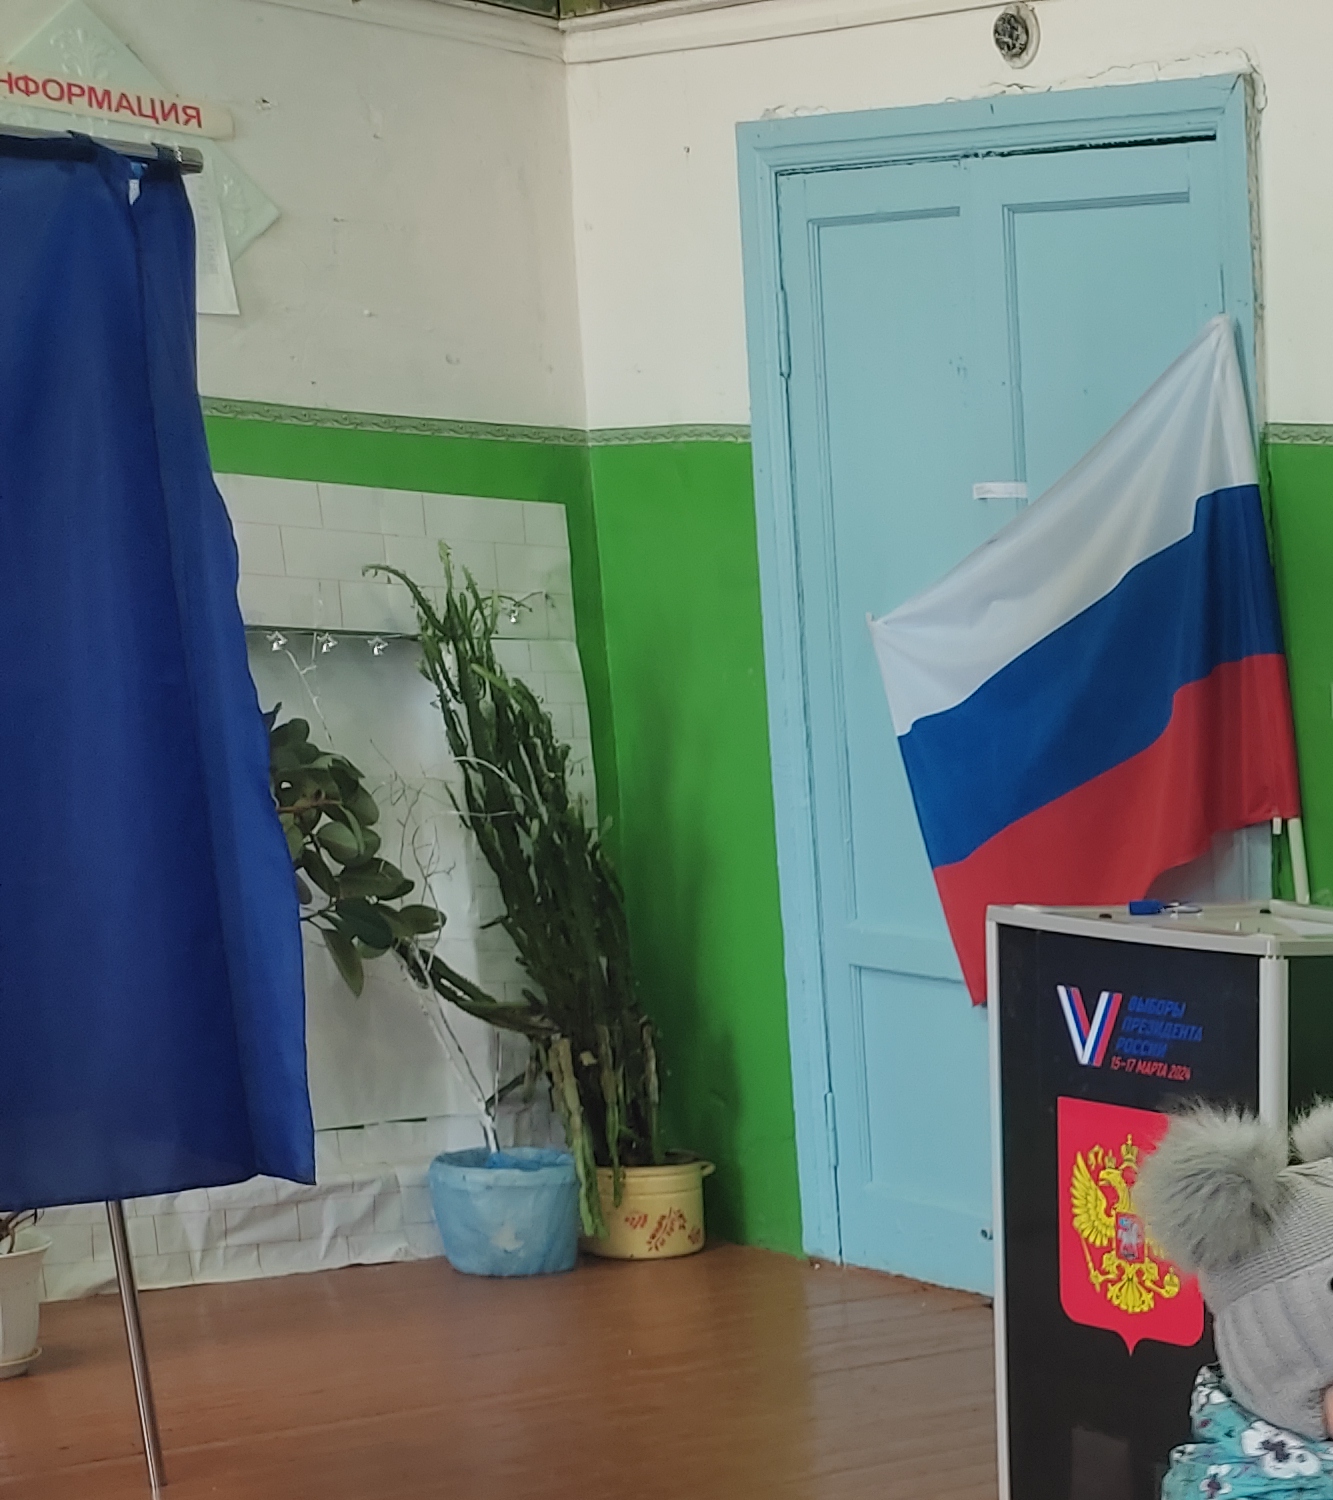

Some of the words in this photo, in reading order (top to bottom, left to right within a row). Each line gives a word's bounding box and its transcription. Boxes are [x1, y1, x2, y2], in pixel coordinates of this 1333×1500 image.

[1127, 995, 1186, 1018] ВЫБОРЫ
[1121, 1016, 1203, 1042] ПРЕЗИДЕНТА
[1115, 1036, 1168, 1058] РОССИИ
[1136, 1060, 1168, 1078] МАРТА
[1167, 1065, 1191, 1081] 2024
